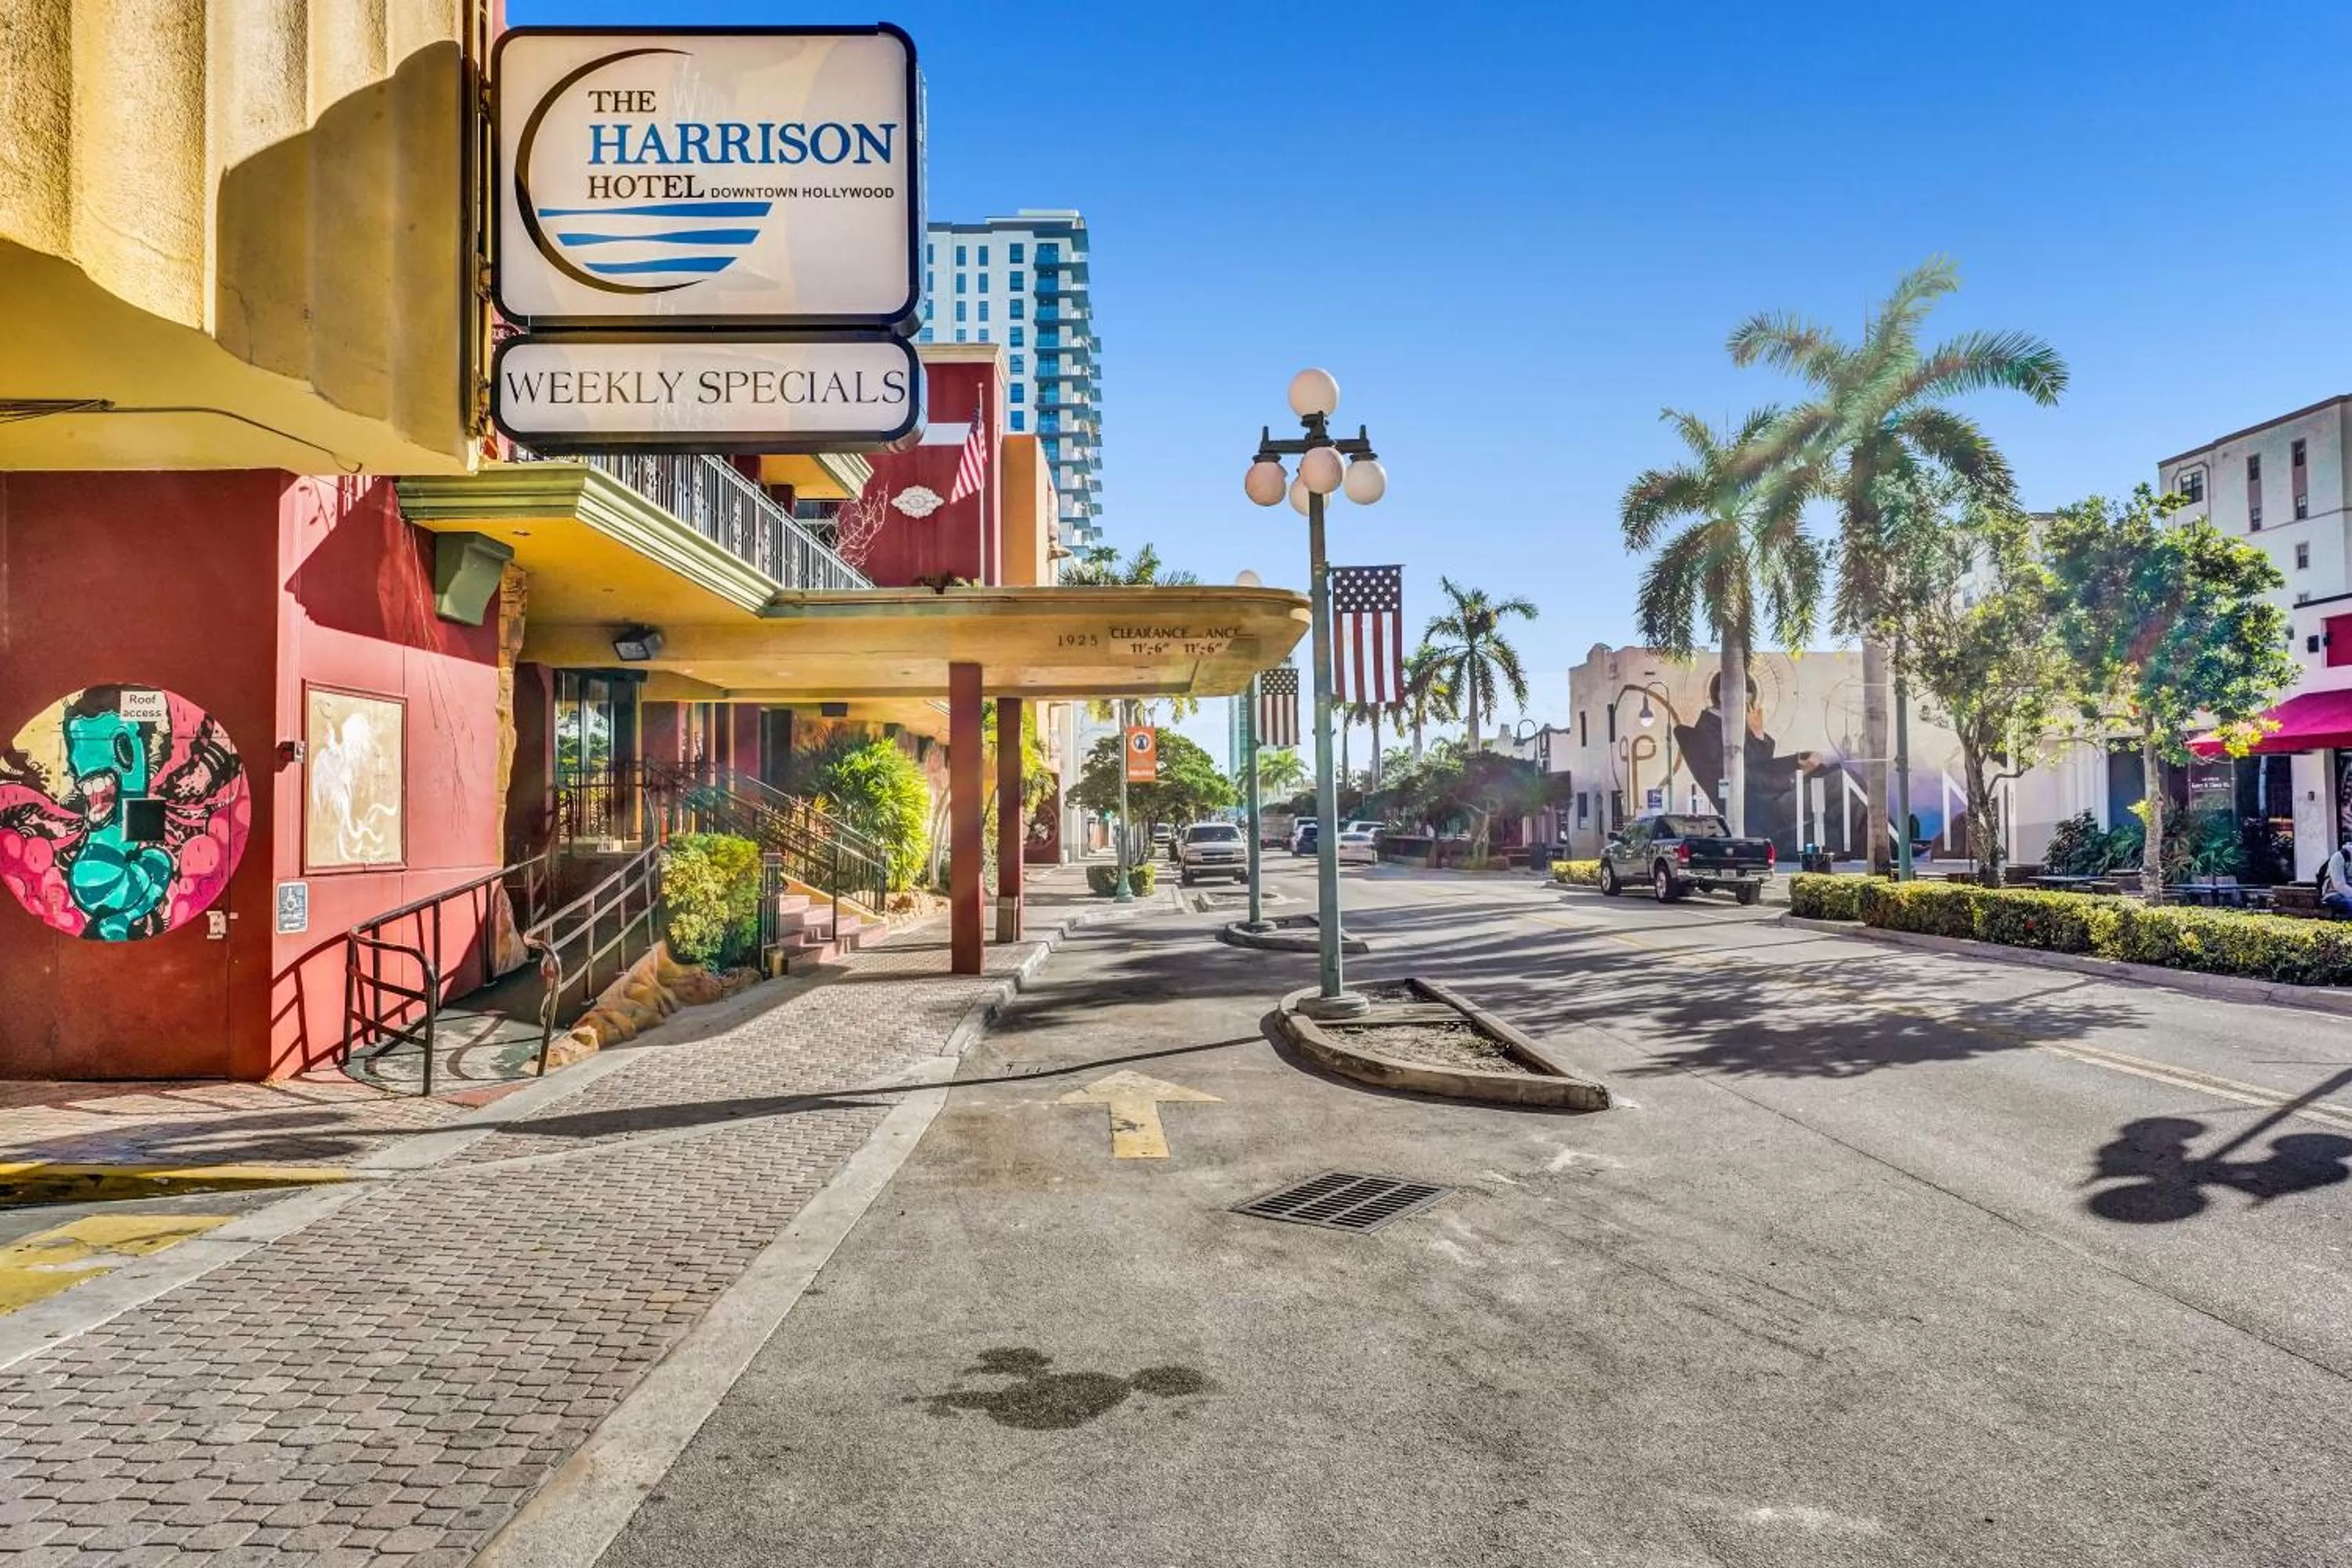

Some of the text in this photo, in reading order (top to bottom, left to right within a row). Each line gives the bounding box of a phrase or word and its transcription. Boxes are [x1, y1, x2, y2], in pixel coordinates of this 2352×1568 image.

[588, 90, 656, 113] THE
[587, 123, 897, 165] HARRISON
[587, 175, 895, 199] HOTEL DOWNTOWN HOLLYWOOD
[506, 371, 906, 404] WEEKLY SPECIALS
[1058, 633, 1098, 647] 1925
[1110, 627, 1189, 639] CLEARANCE
[129, 694, 157, 705] Roof
[122, 710, 162, 718] access
